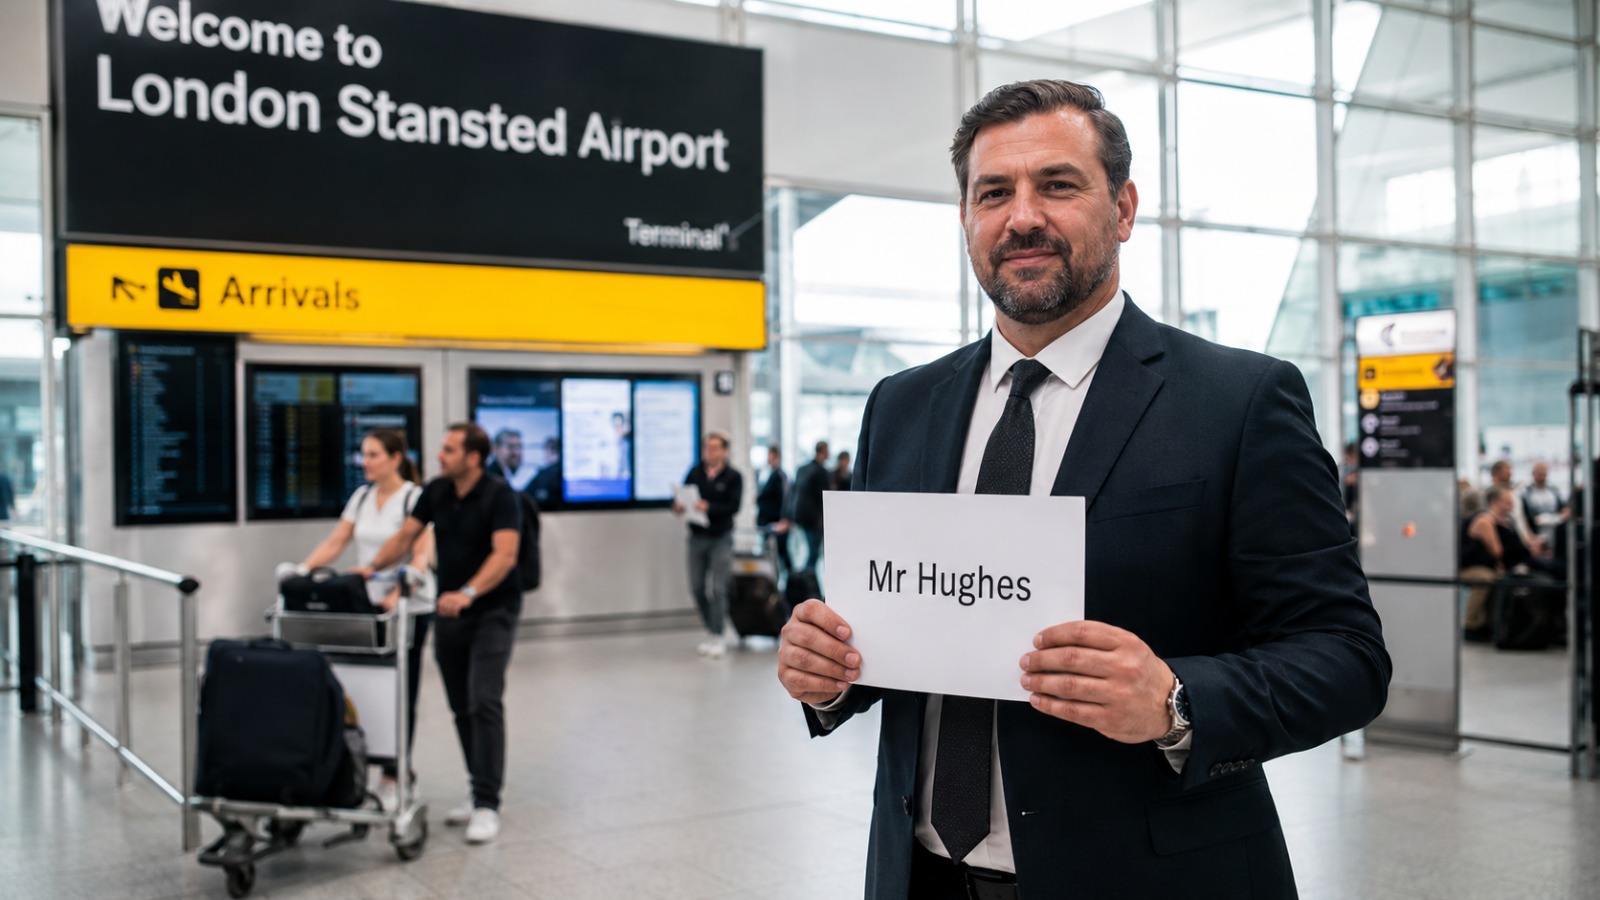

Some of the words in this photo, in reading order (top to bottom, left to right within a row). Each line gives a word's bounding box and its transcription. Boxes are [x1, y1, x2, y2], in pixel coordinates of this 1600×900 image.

[96, 0, 324, 61] Welcome
[334, 24, 383, 68] to
[97, 53, 321, 132] London
[337, 83, 567, 156] Stansted
[578, 111, 730, 176] Airport
[220, 276, 360, 310] Arrivals
[868, 560, 906, 593] Mr
[918, 562, 1031, 606] Hughes
